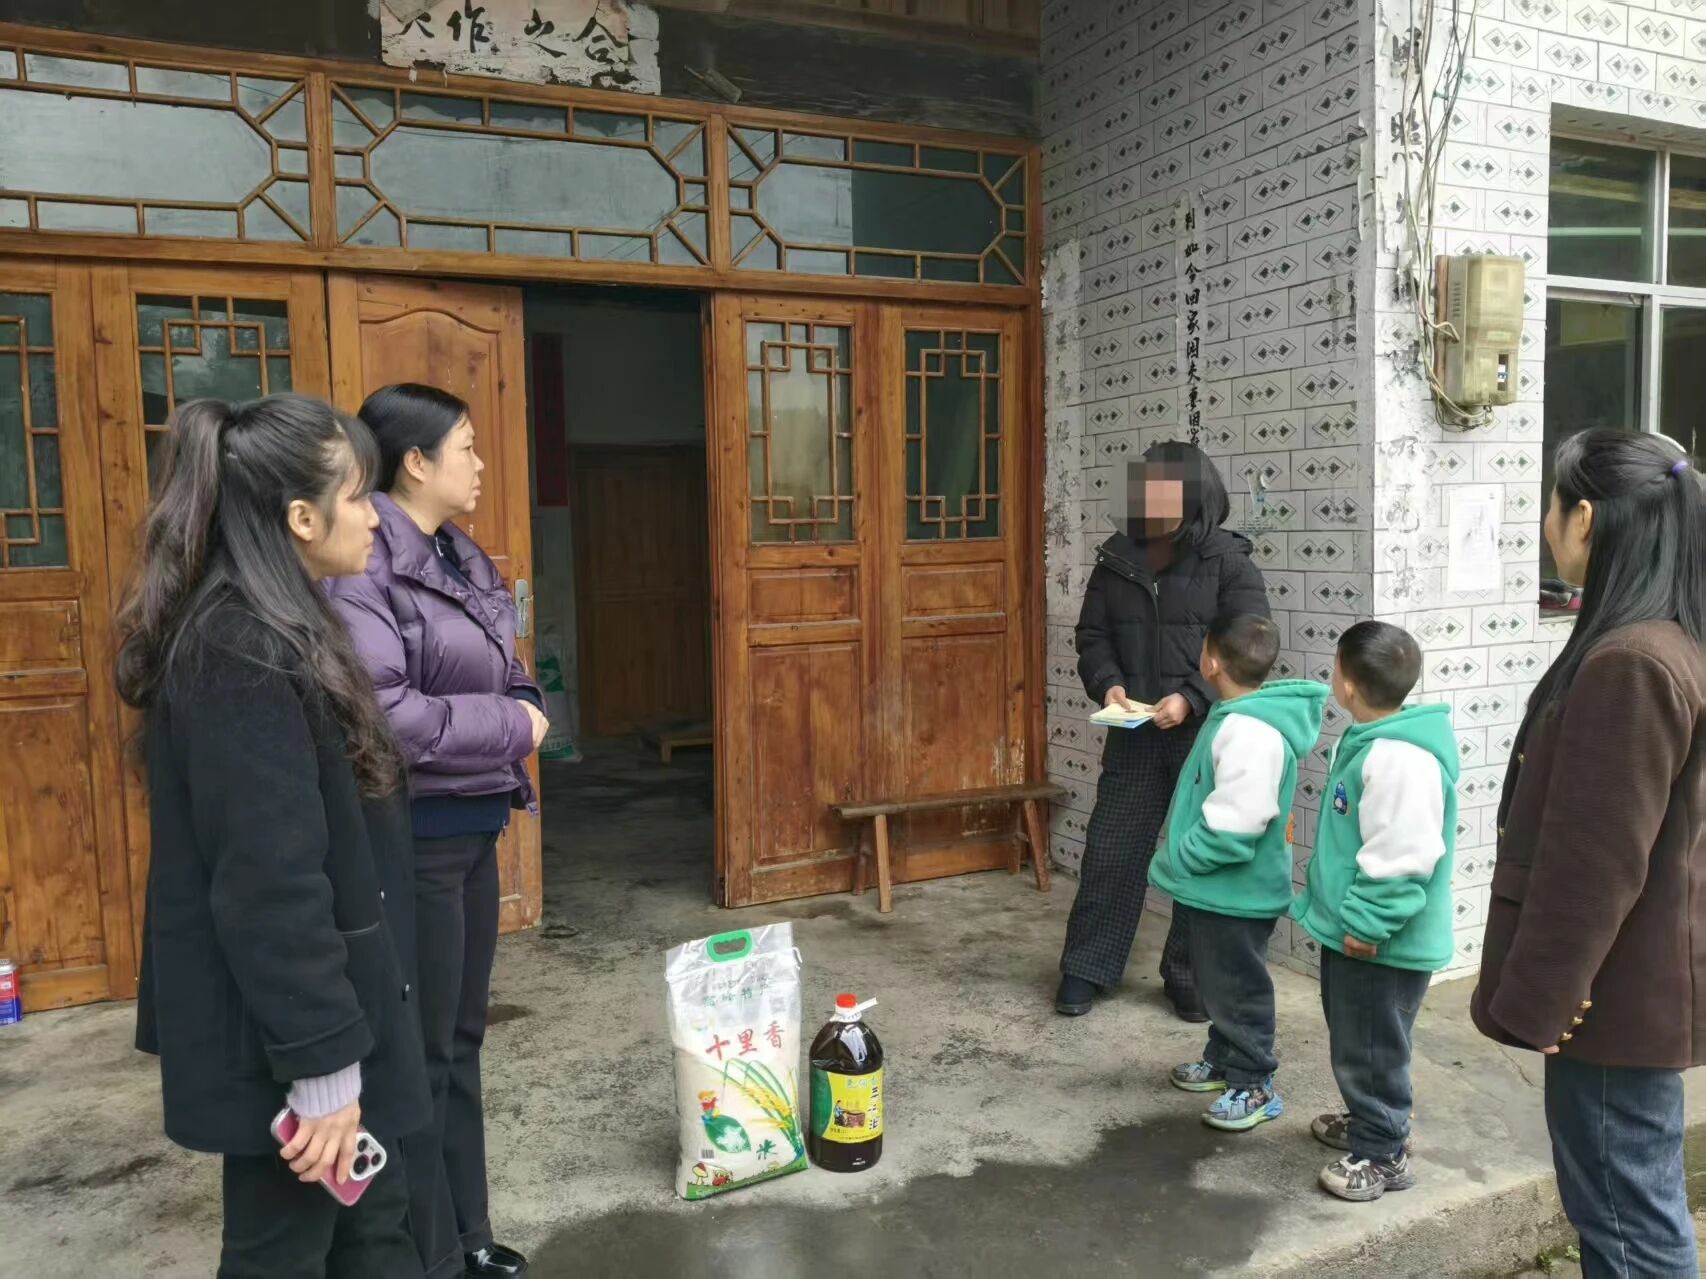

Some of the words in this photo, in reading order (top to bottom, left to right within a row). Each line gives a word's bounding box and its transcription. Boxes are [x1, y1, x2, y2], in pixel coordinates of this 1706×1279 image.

[705, 1020, 785, 1061] 十里香
[756, 1138, 777, 1160] 米
